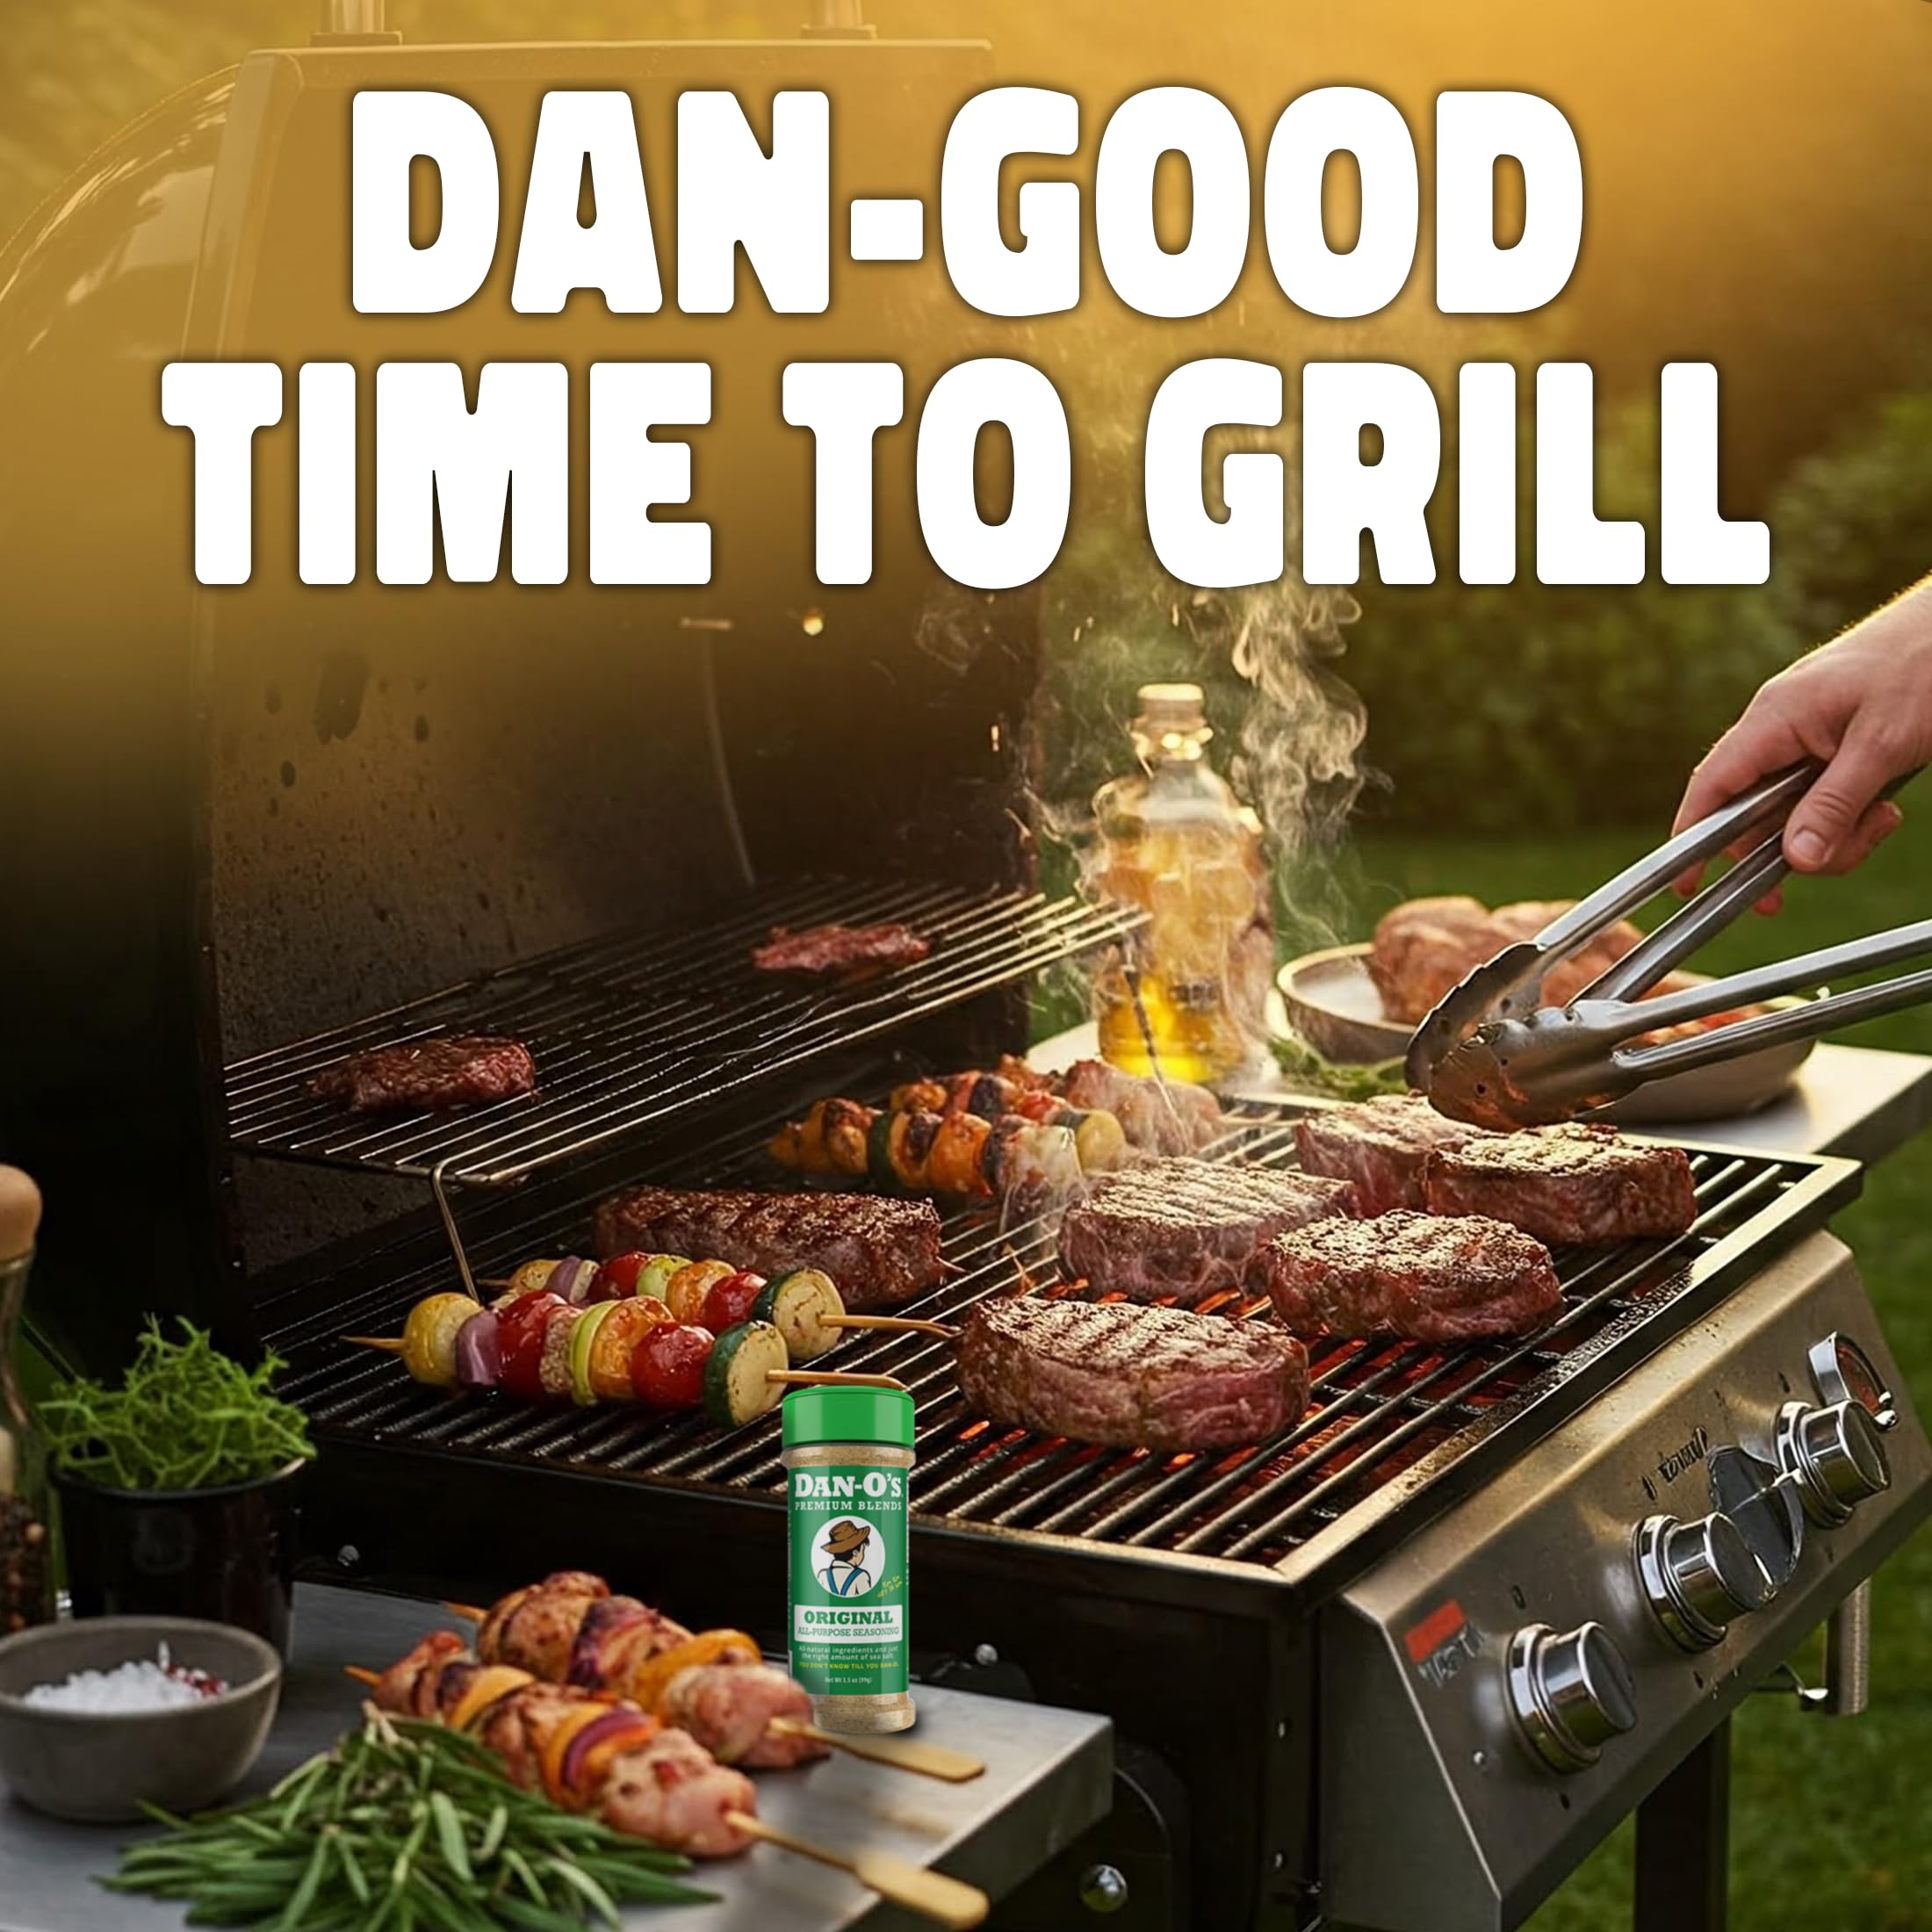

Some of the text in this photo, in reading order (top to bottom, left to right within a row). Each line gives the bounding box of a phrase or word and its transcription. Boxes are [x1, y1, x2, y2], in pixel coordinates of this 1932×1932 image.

[795, 1501, 902, 1510] PREMIUM BLENDS
[804, 1611, 893, 1625] ORIGINAL
[797, 1626, 899, 1637] ALL-PURPOSE SEASONING
[832, 1646, 873, 1654] ingredients
